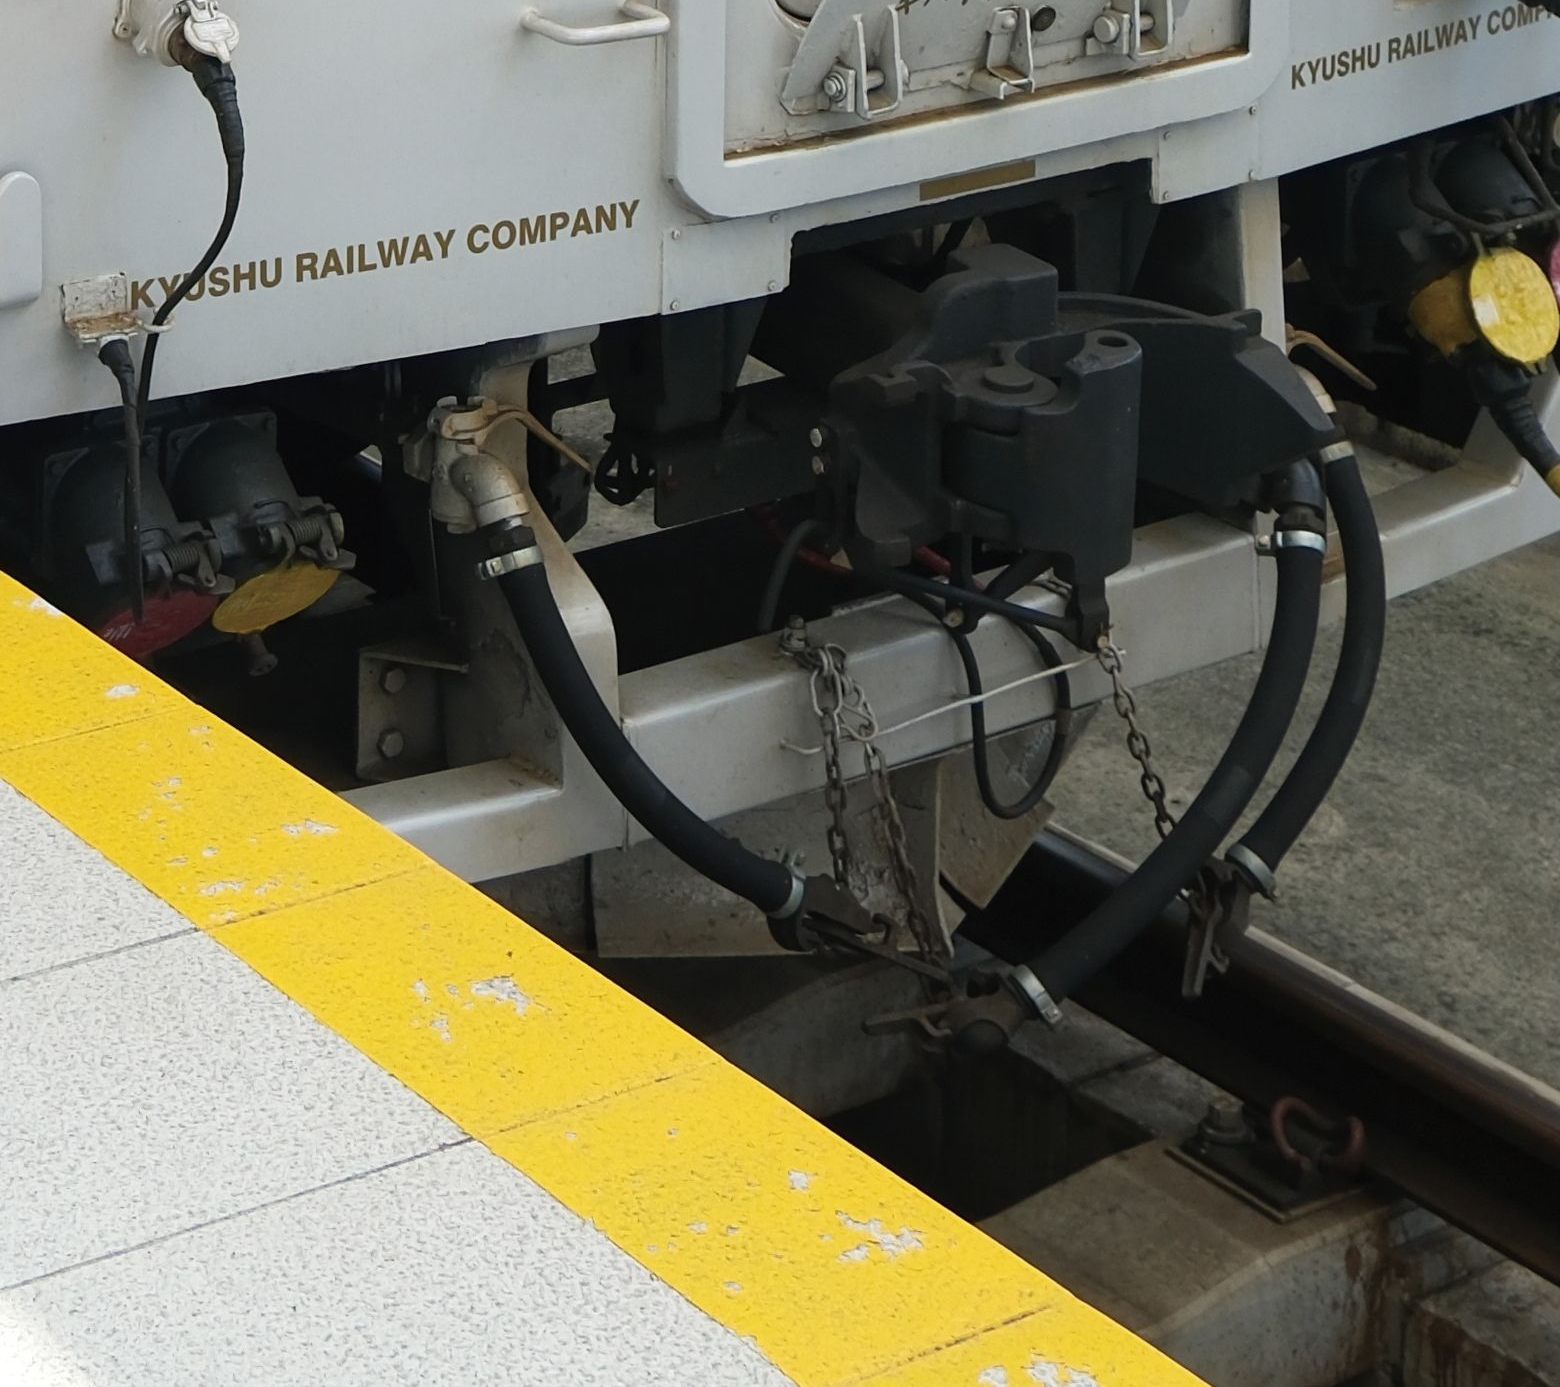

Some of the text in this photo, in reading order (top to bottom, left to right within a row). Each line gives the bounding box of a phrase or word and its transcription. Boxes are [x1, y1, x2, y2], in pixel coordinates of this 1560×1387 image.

[1291, 3, 1553, 90] KYUSHU RAILWAY COMP
[295, 229, 456, 283] RAILWAY
[466, 199, 640, 254] COMPANY
